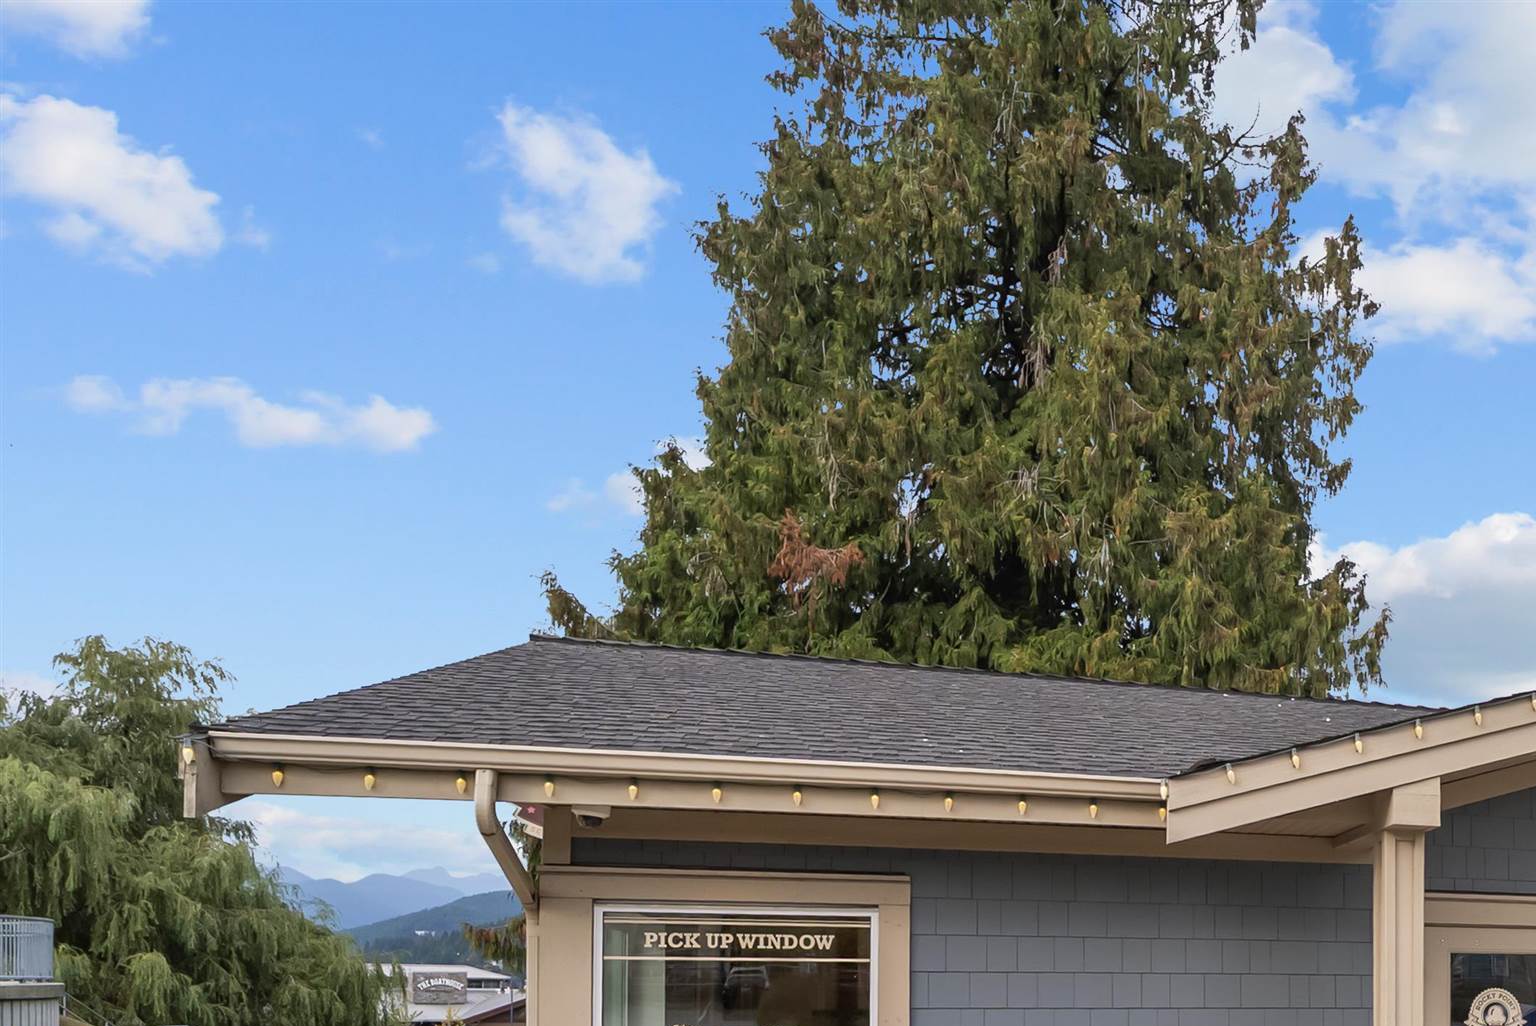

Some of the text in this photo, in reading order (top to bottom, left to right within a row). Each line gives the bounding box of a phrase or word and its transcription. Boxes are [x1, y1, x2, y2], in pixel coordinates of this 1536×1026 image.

[644, 932, 835, 950] PICK UP WINDOW
[1475, 993, 1517, 1011] ROCKY POINT
